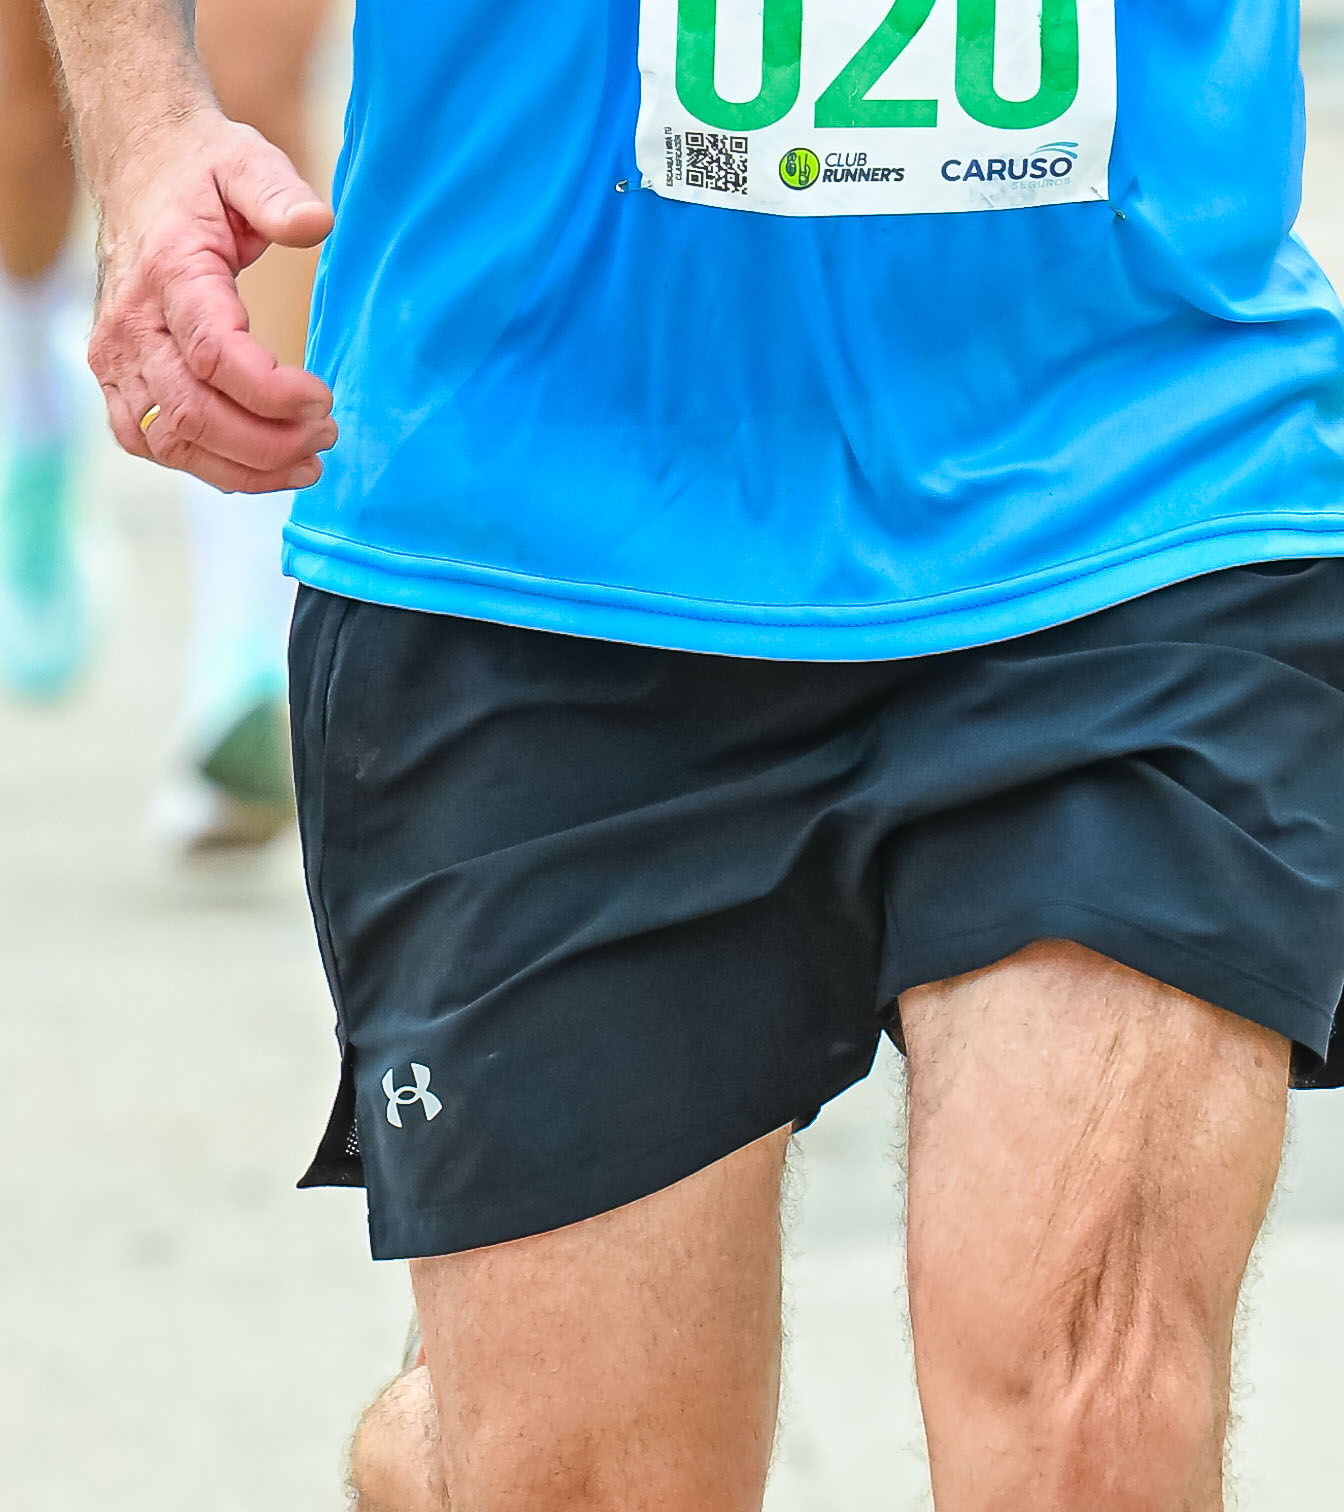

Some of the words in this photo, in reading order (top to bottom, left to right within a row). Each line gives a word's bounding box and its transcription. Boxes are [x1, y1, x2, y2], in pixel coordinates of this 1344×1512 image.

[825, 152, 868, 167] CLUB
[822, 167, 905, 183] RUNNER'S
[940, 157, 1073, 182] CARUSO
[1011, 177, 1071, 190] SEGUROS
